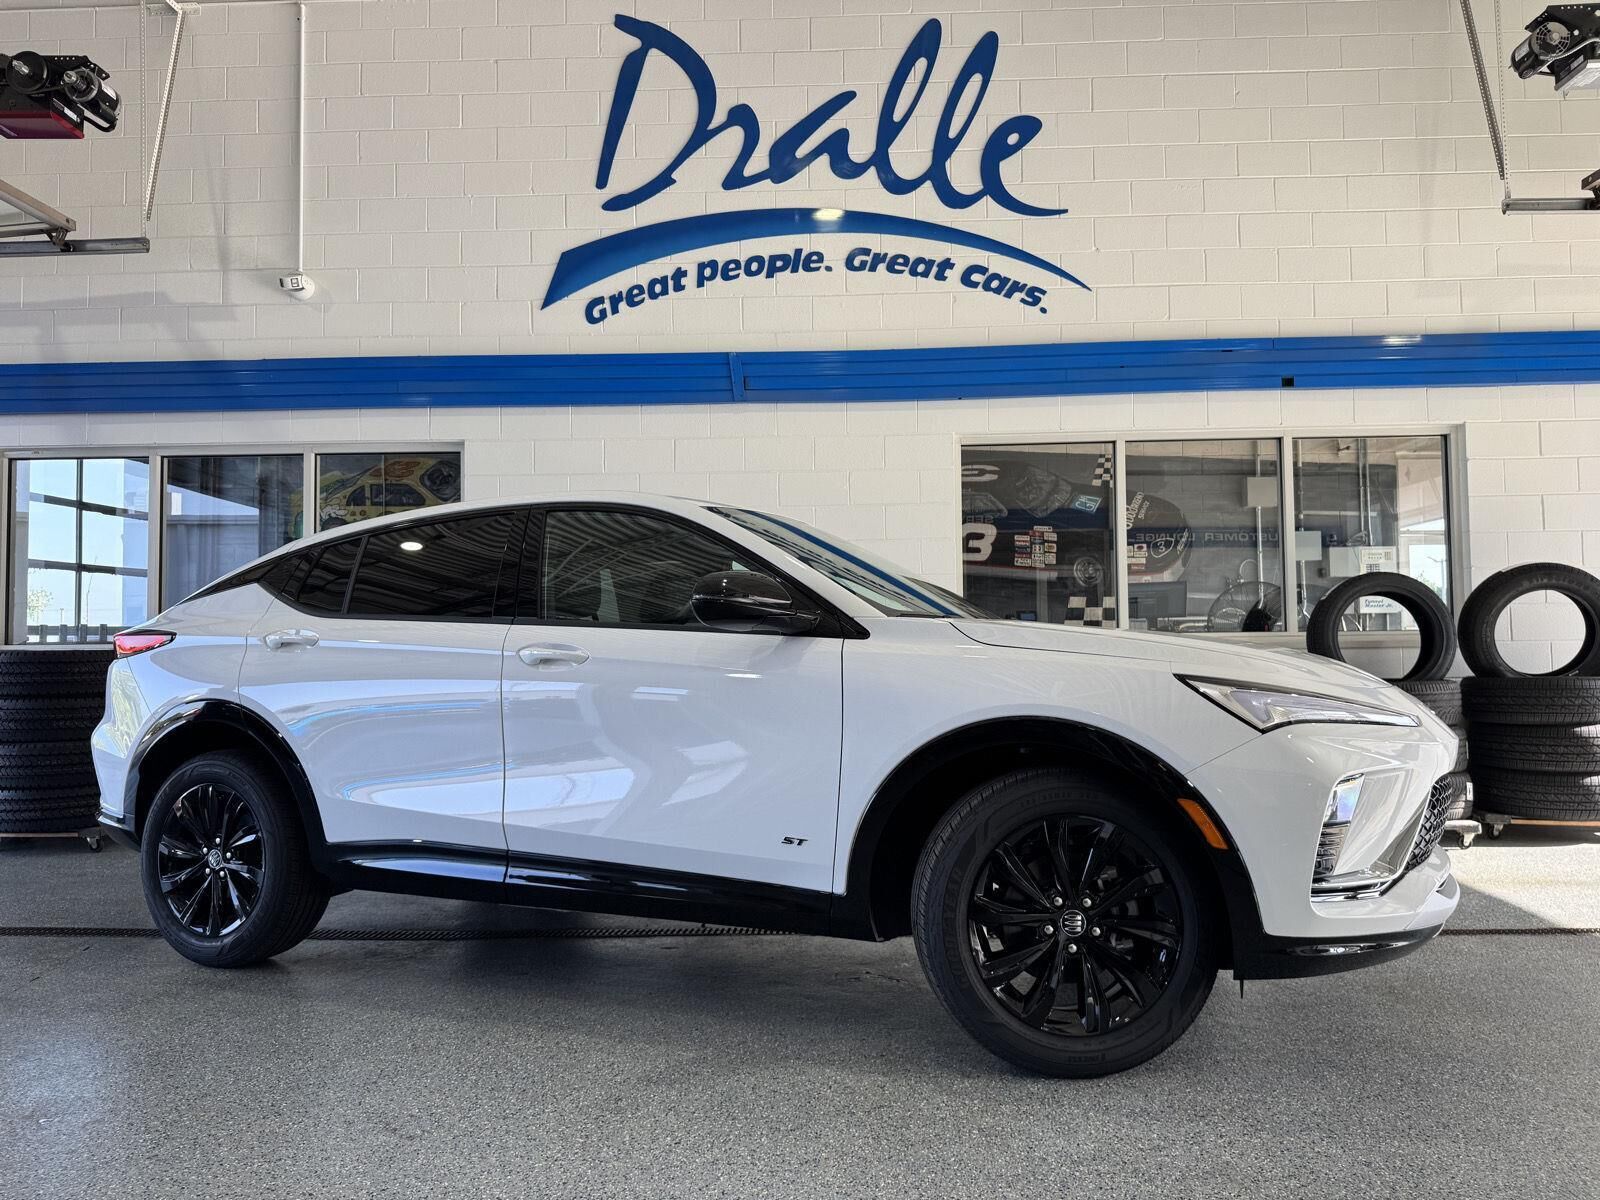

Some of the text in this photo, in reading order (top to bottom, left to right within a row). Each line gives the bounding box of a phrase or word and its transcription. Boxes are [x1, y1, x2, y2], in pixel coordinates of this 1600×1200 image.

[595, 14, 1068, 217] Dralle
[585, 247, 1049, 325] Great people. Great Cars.
[781, 836, 808, 846] ST
